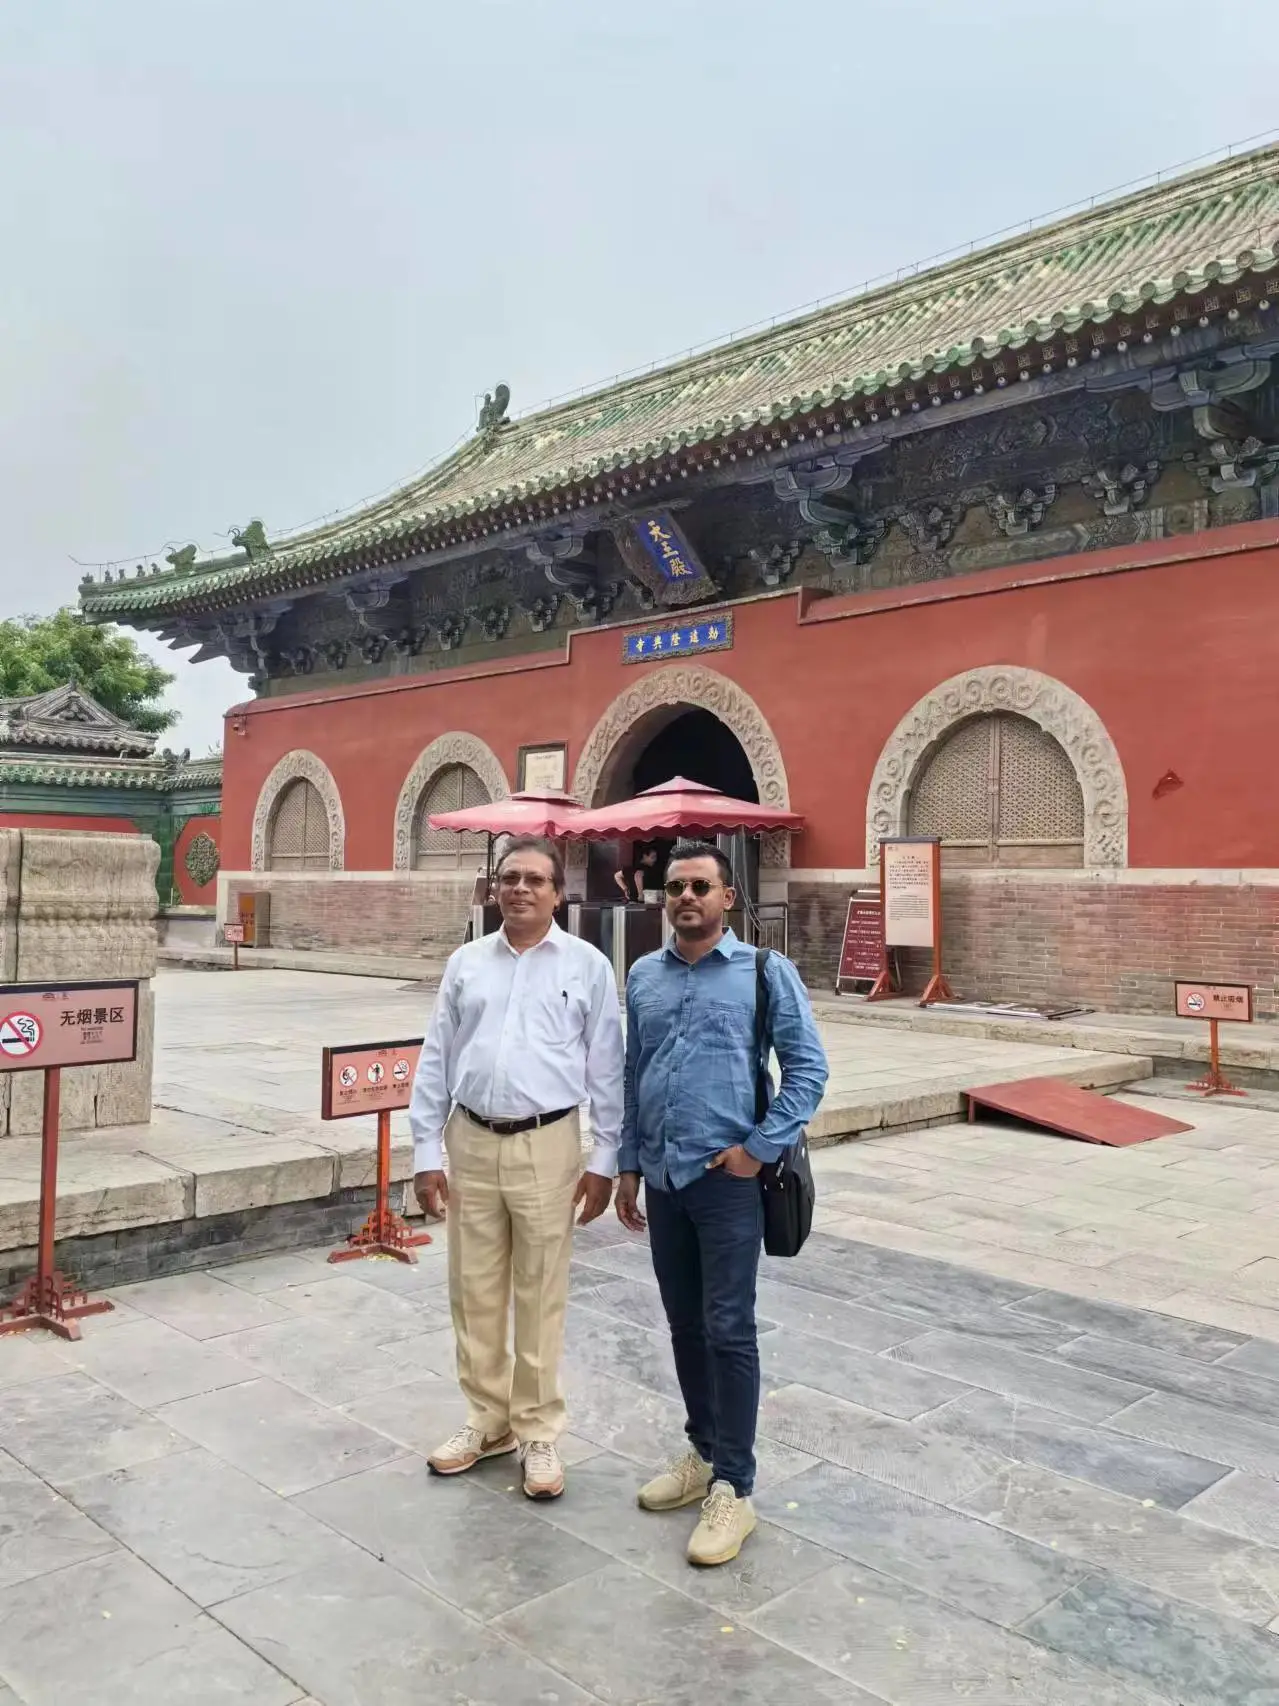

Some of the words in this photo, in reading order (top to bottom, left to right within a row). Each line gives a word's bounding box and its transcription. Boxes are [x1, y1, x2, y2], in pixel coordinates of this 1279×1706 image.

[645, 520, 693, 577] 天王殿
[60, 1007, 125, 1027] 无烟景区
